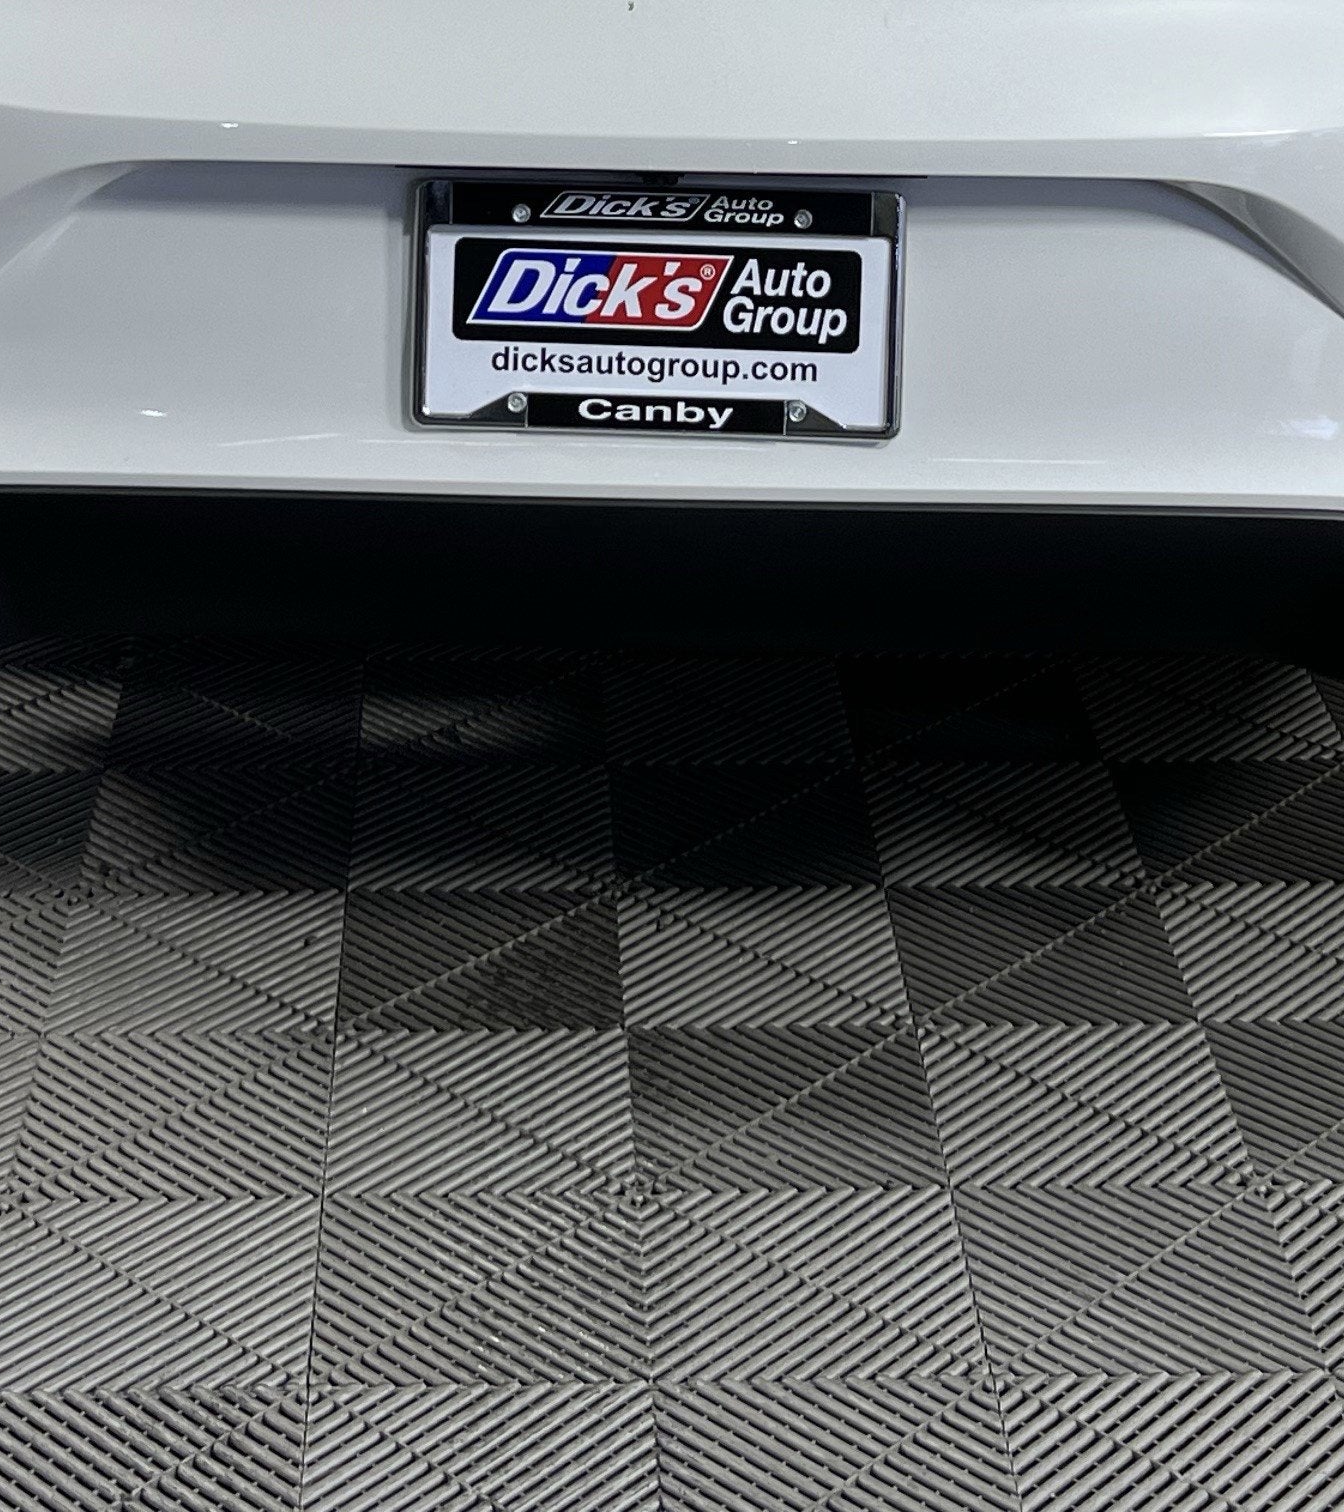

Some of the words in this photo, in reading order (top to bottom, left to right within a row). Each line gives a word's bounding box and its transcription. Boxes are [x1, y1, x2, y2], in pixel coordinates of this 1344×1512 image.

[553, 192, 694, 217] Dick's
[704, 208, 784, 227] Group
[713, 195, 773, 211] Auto
[487, 257, 704, 320] Dick's
[730, 258, 831, 298] Auto
[722, 295, 847, 344] Group
[491, 346, 818, 385] dicksautogroup.com
[577, 398, 734, 427] Canby
